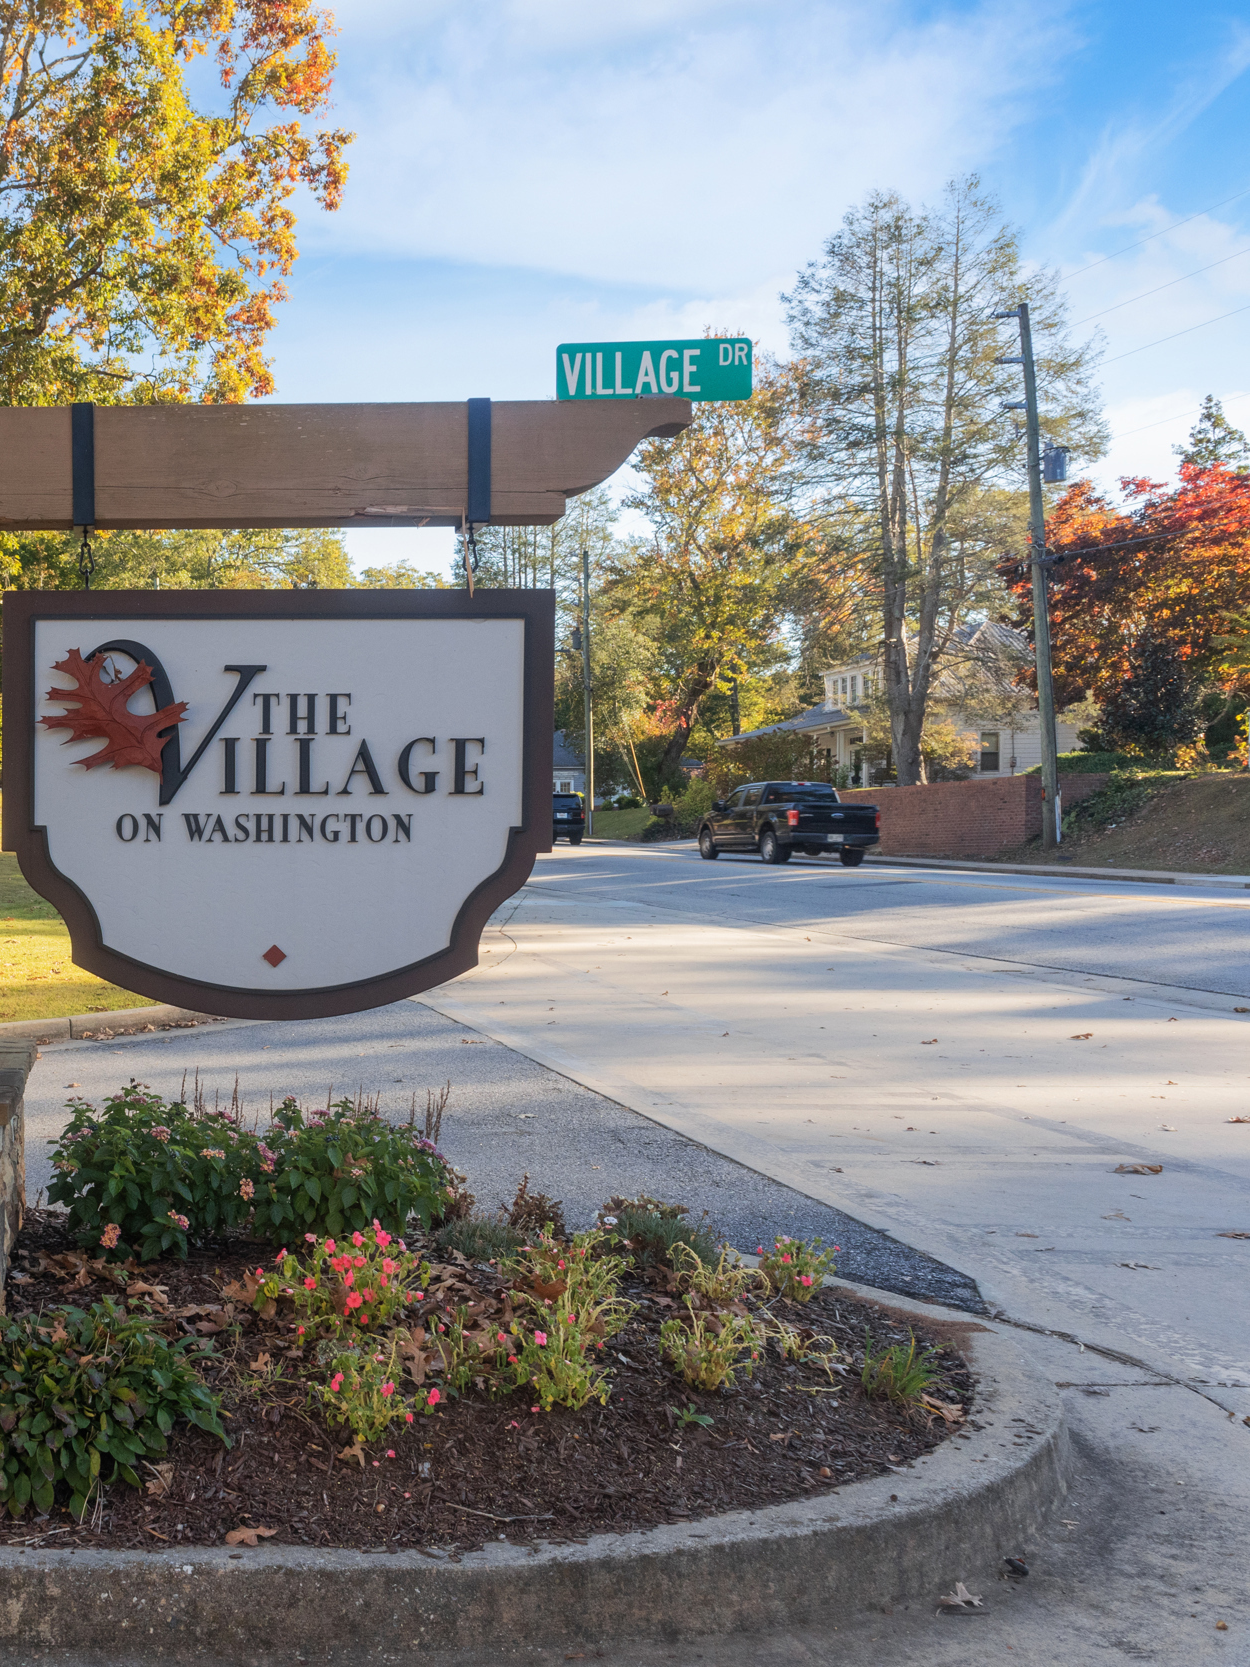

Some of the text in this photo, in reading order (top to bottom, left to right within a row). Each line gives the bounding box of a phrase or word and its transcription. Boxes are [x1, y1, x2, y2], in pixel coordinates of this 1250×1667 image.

[561, 343, 749, 396] VILLAGE DR
[84, 639, 485, 806] VILLAGE
[252, 692, 352, 735] THE
[115, 813, 414, 843] ON WASHINGTON
